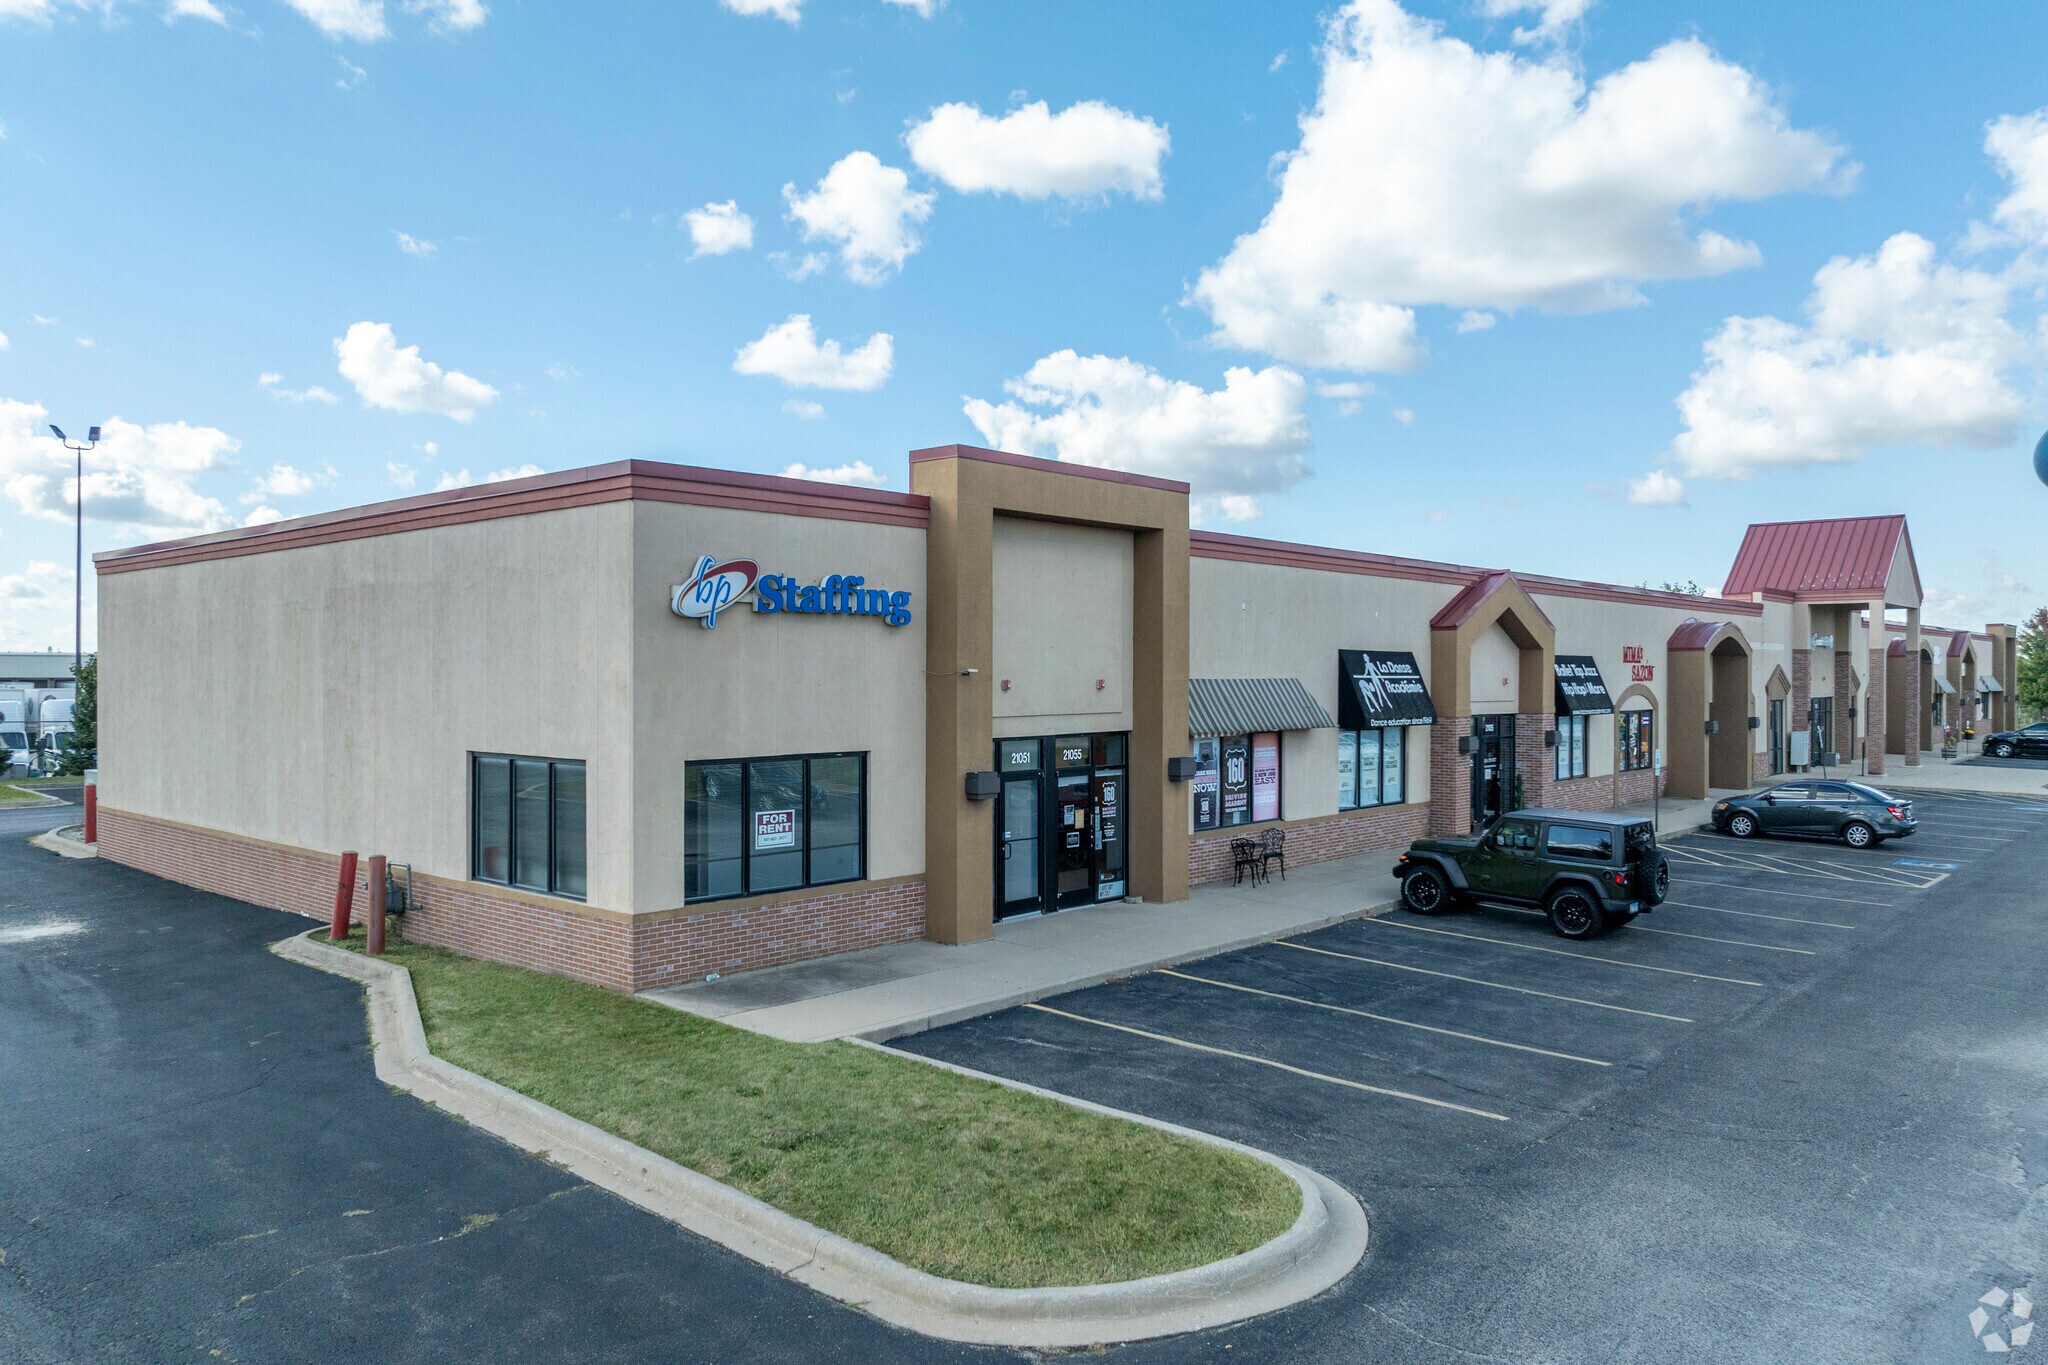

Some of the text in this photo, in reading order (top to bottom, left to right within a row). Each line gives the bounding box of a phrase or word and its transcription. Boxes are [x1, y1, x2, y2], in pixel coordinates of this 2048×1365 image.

[757, 574, 912, 626] Staffing
[1376, 661, 1388, 672] La
[1011, 752, 1029, 763] 21051
[1063, 749, 1081, 760] 21055
[1227, 757, 1244, 782] 160
[1254, 777, 1275, 785] EASY
[1193, 782, 1217, 793] NOW
[1103, 786, 1114, 801] 160
[762, 813, 787, 824] FOR
[758, 822, 791, 834] RENT
